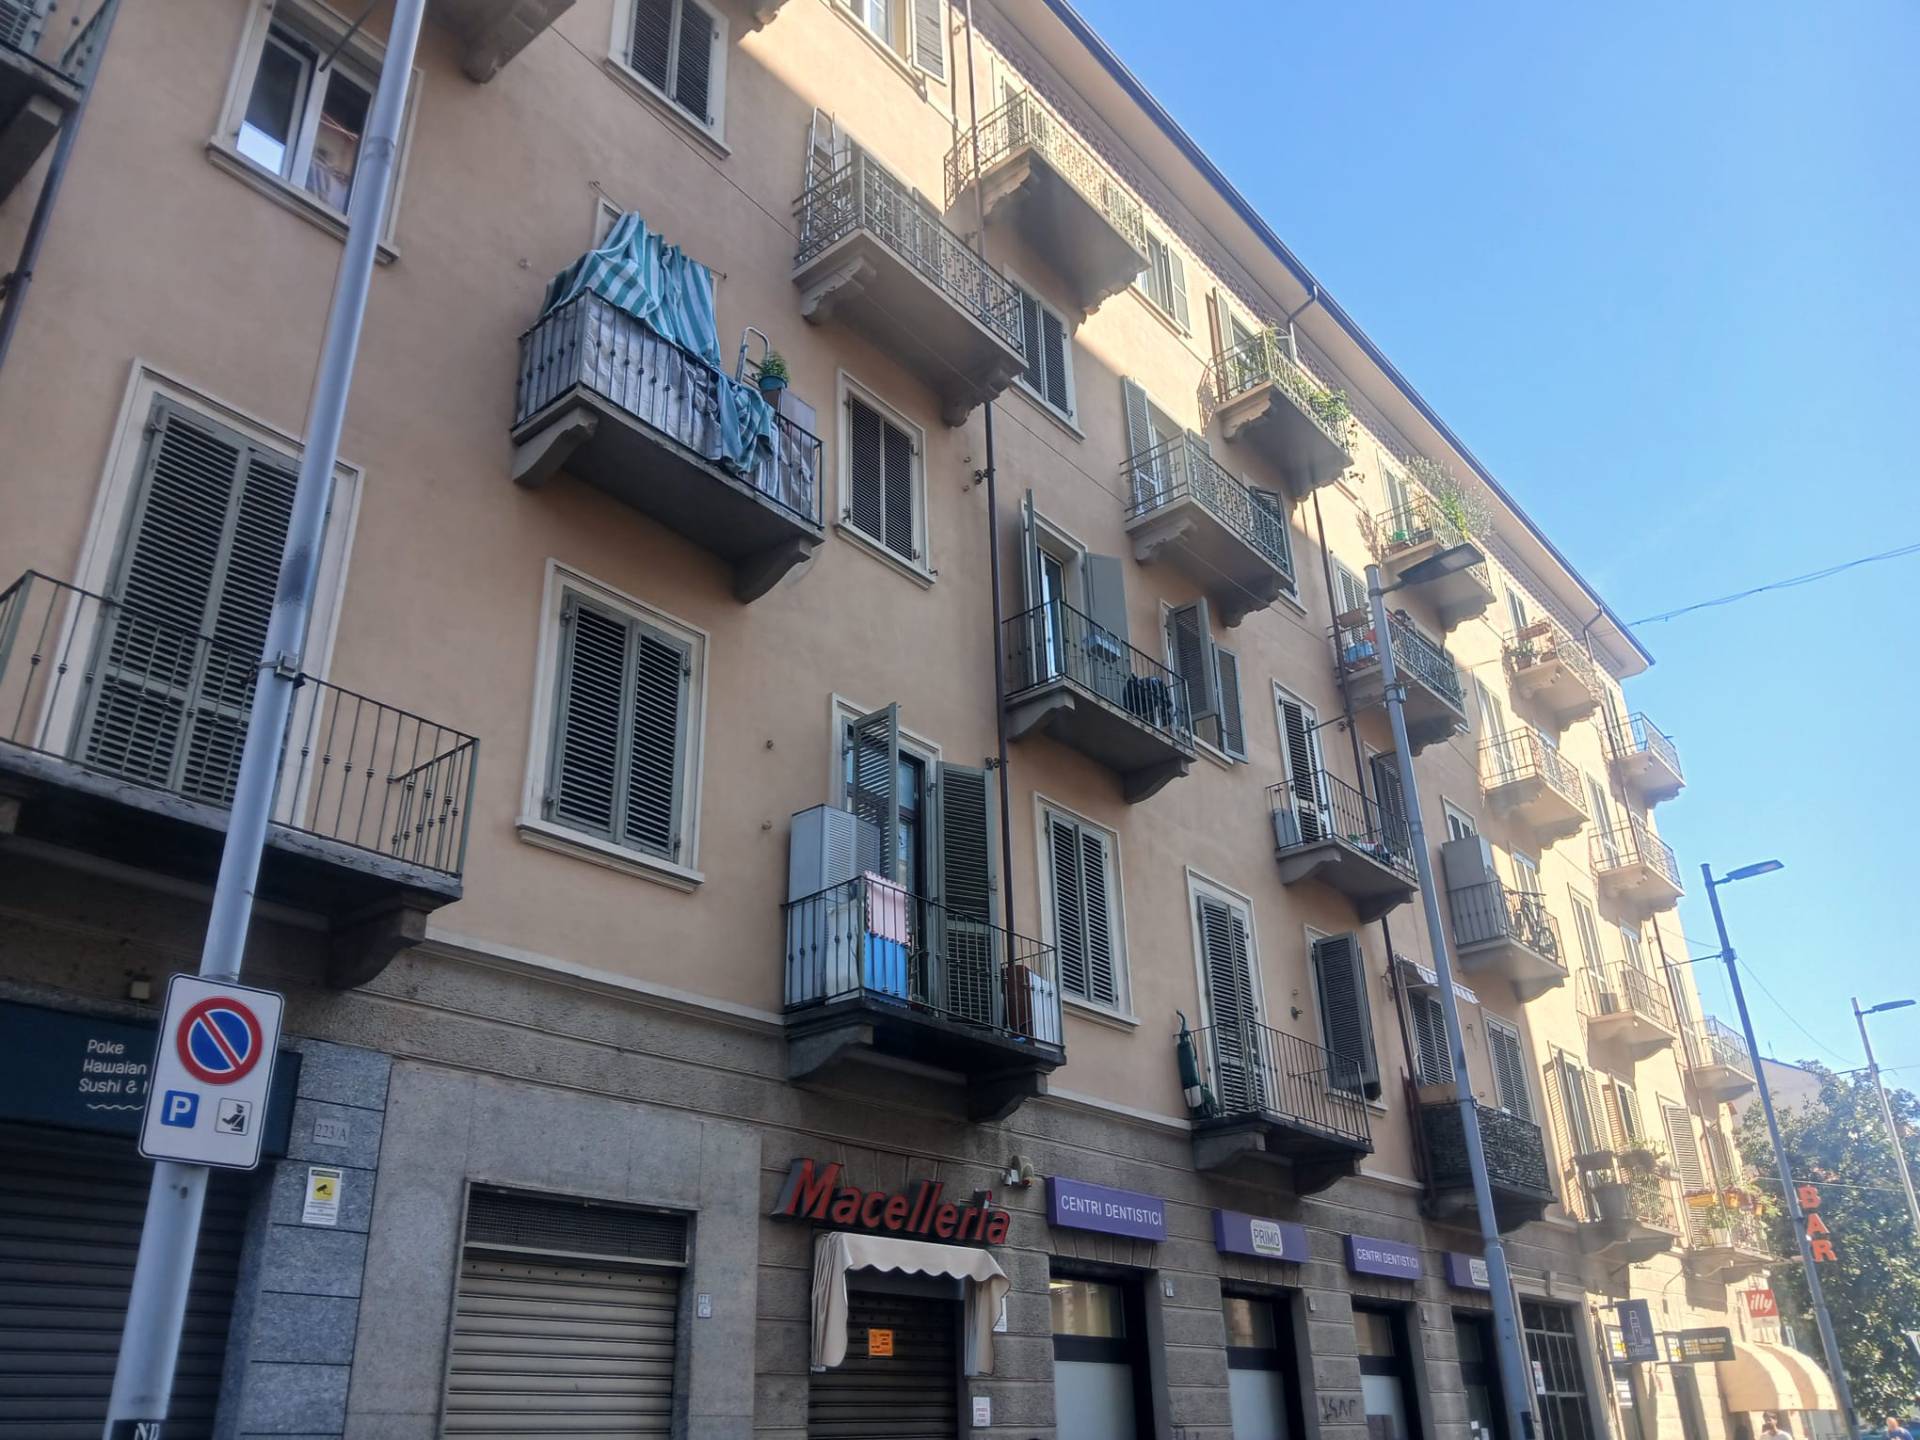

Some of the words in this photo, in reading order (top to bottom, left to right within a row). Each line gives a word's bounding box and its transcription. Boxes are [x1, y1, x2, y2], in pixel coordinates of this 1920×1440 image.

[87, 1039, 125, 1054] Poke
[82, 1058, 147, 1075] Hawaian
[78, 1078, 122, 1093] Sushi
[126, 1080, 138, 1094] &
[168, 1095, 192, 1122] P
[782, 1157, 1011, 1245] Macelleria
[1061, 1194, 1101, 1216] CENTRI
[1105, 1203, 1162, 1225] DENTISTICI
[1798, 1185, 1838, 1263] BAR
[1253, 1228, 1281, 1247] PRIMO
[1356, 1248, 1382, 1262] CENTRI
[1382, 1252, 1419, 1269] DENTISTICI
[1750, 1293, 1773, 1313] illy
